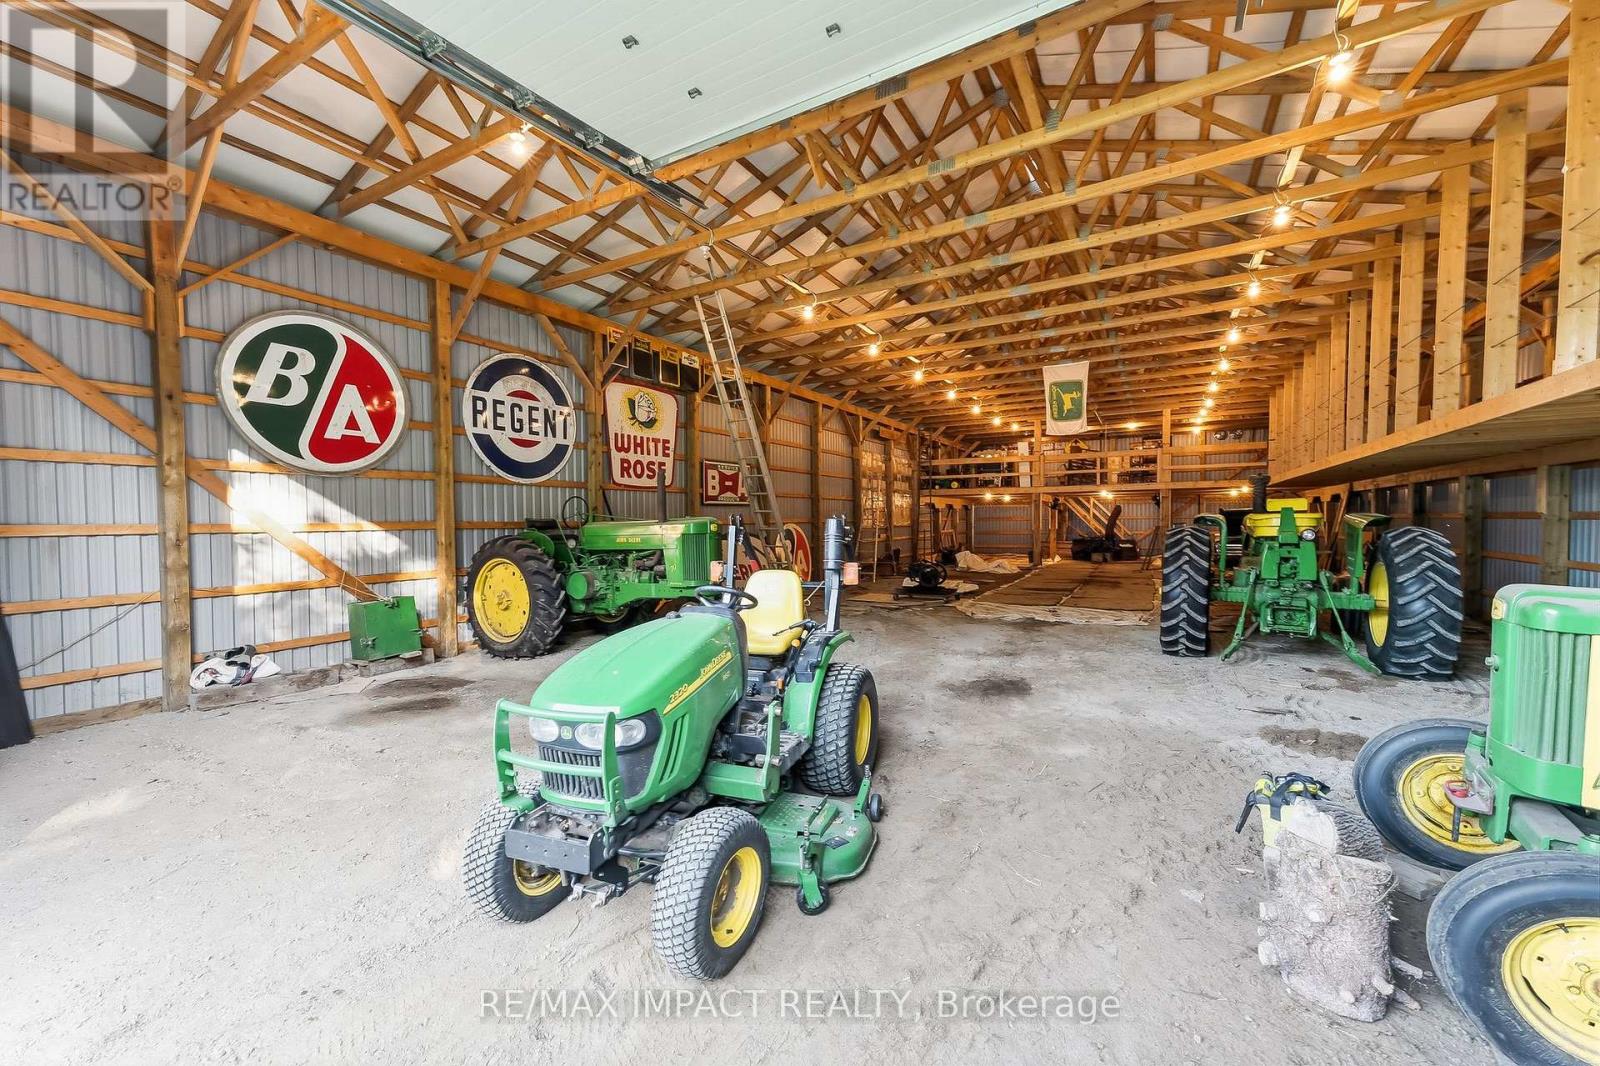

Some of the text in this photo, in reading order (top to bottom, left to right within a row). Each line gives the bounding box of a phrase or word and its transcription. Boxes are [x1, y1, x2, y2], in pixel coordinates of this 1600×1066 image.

[246, 342, 381, 444] B A
[471, 394, 571, 440] REGENT
[614, 432, 671, 458] WHITE
